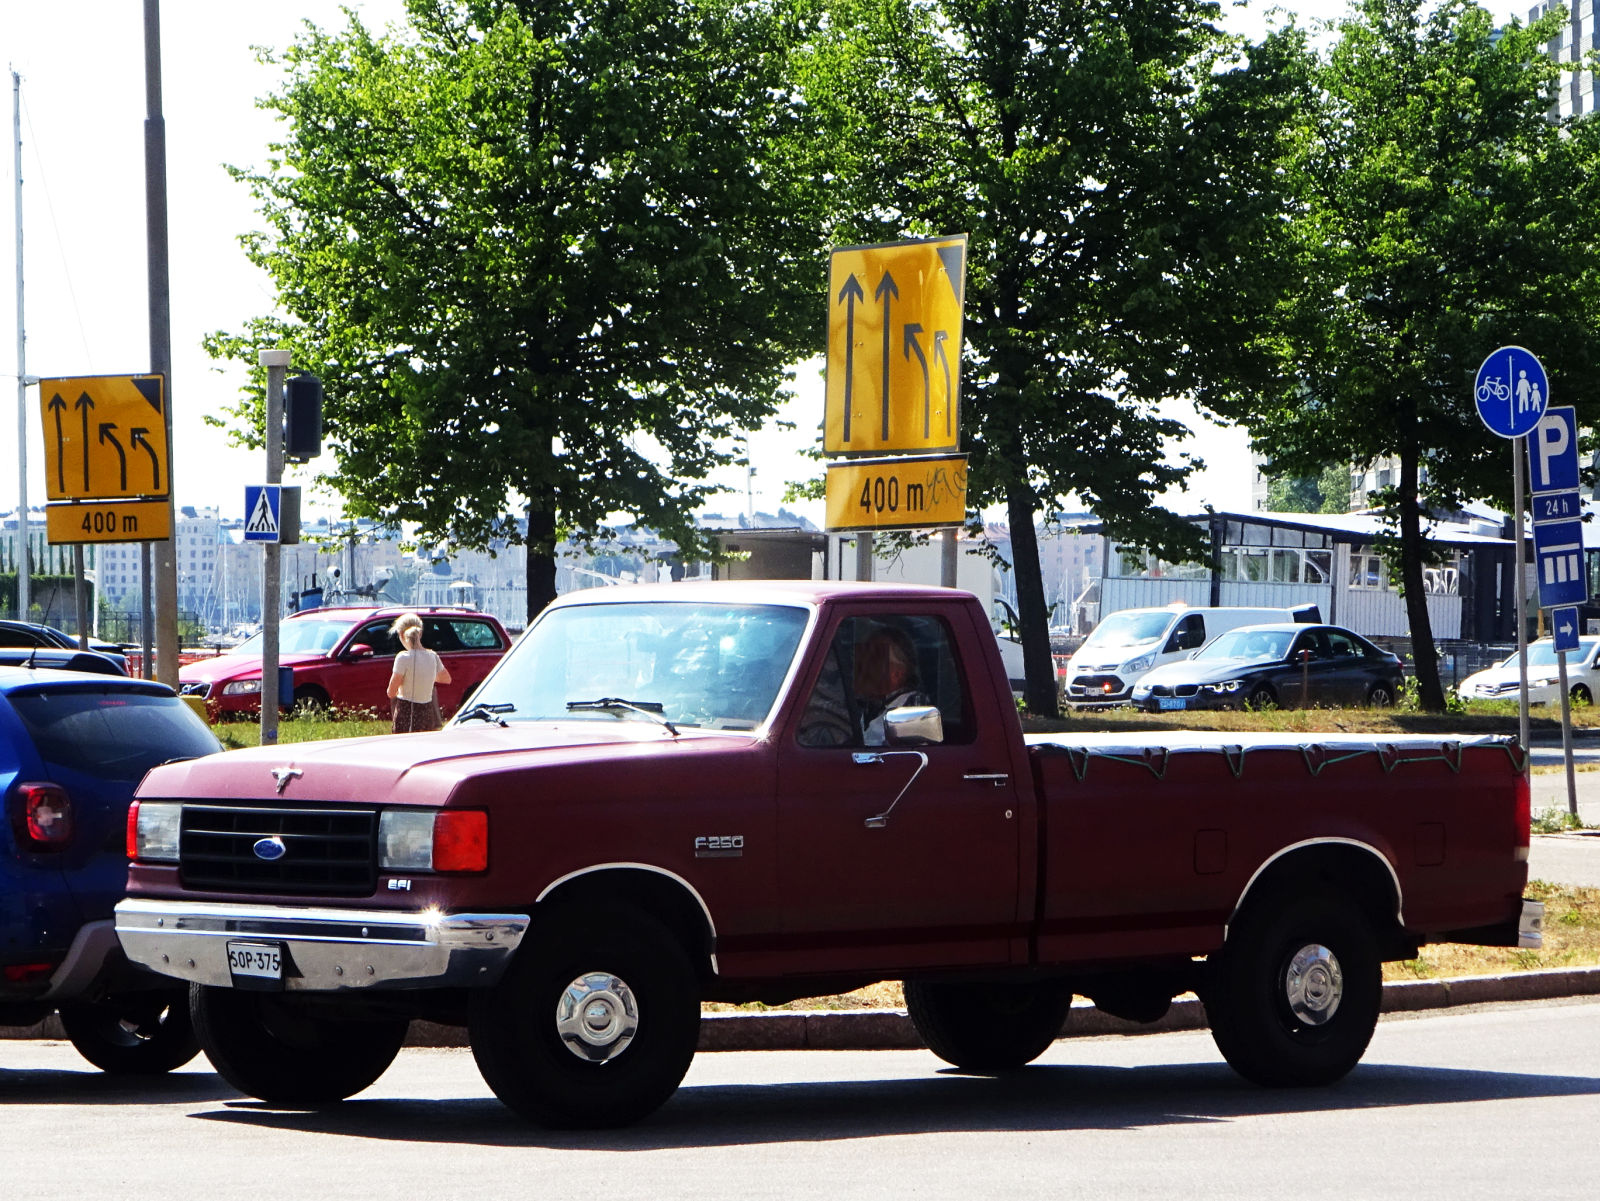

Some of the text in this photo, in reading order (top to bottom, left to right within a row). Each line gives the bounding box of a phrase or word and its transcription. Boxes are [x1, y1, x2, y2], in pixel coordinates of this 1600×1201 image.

[1538, 415, 1569, 485] P
[860, 476, 899, 513] 400
[906, 483, 924, 511] m
[1546, 498, 1569, 516] 24 h
[81, 511, 138, 534] 400 m
